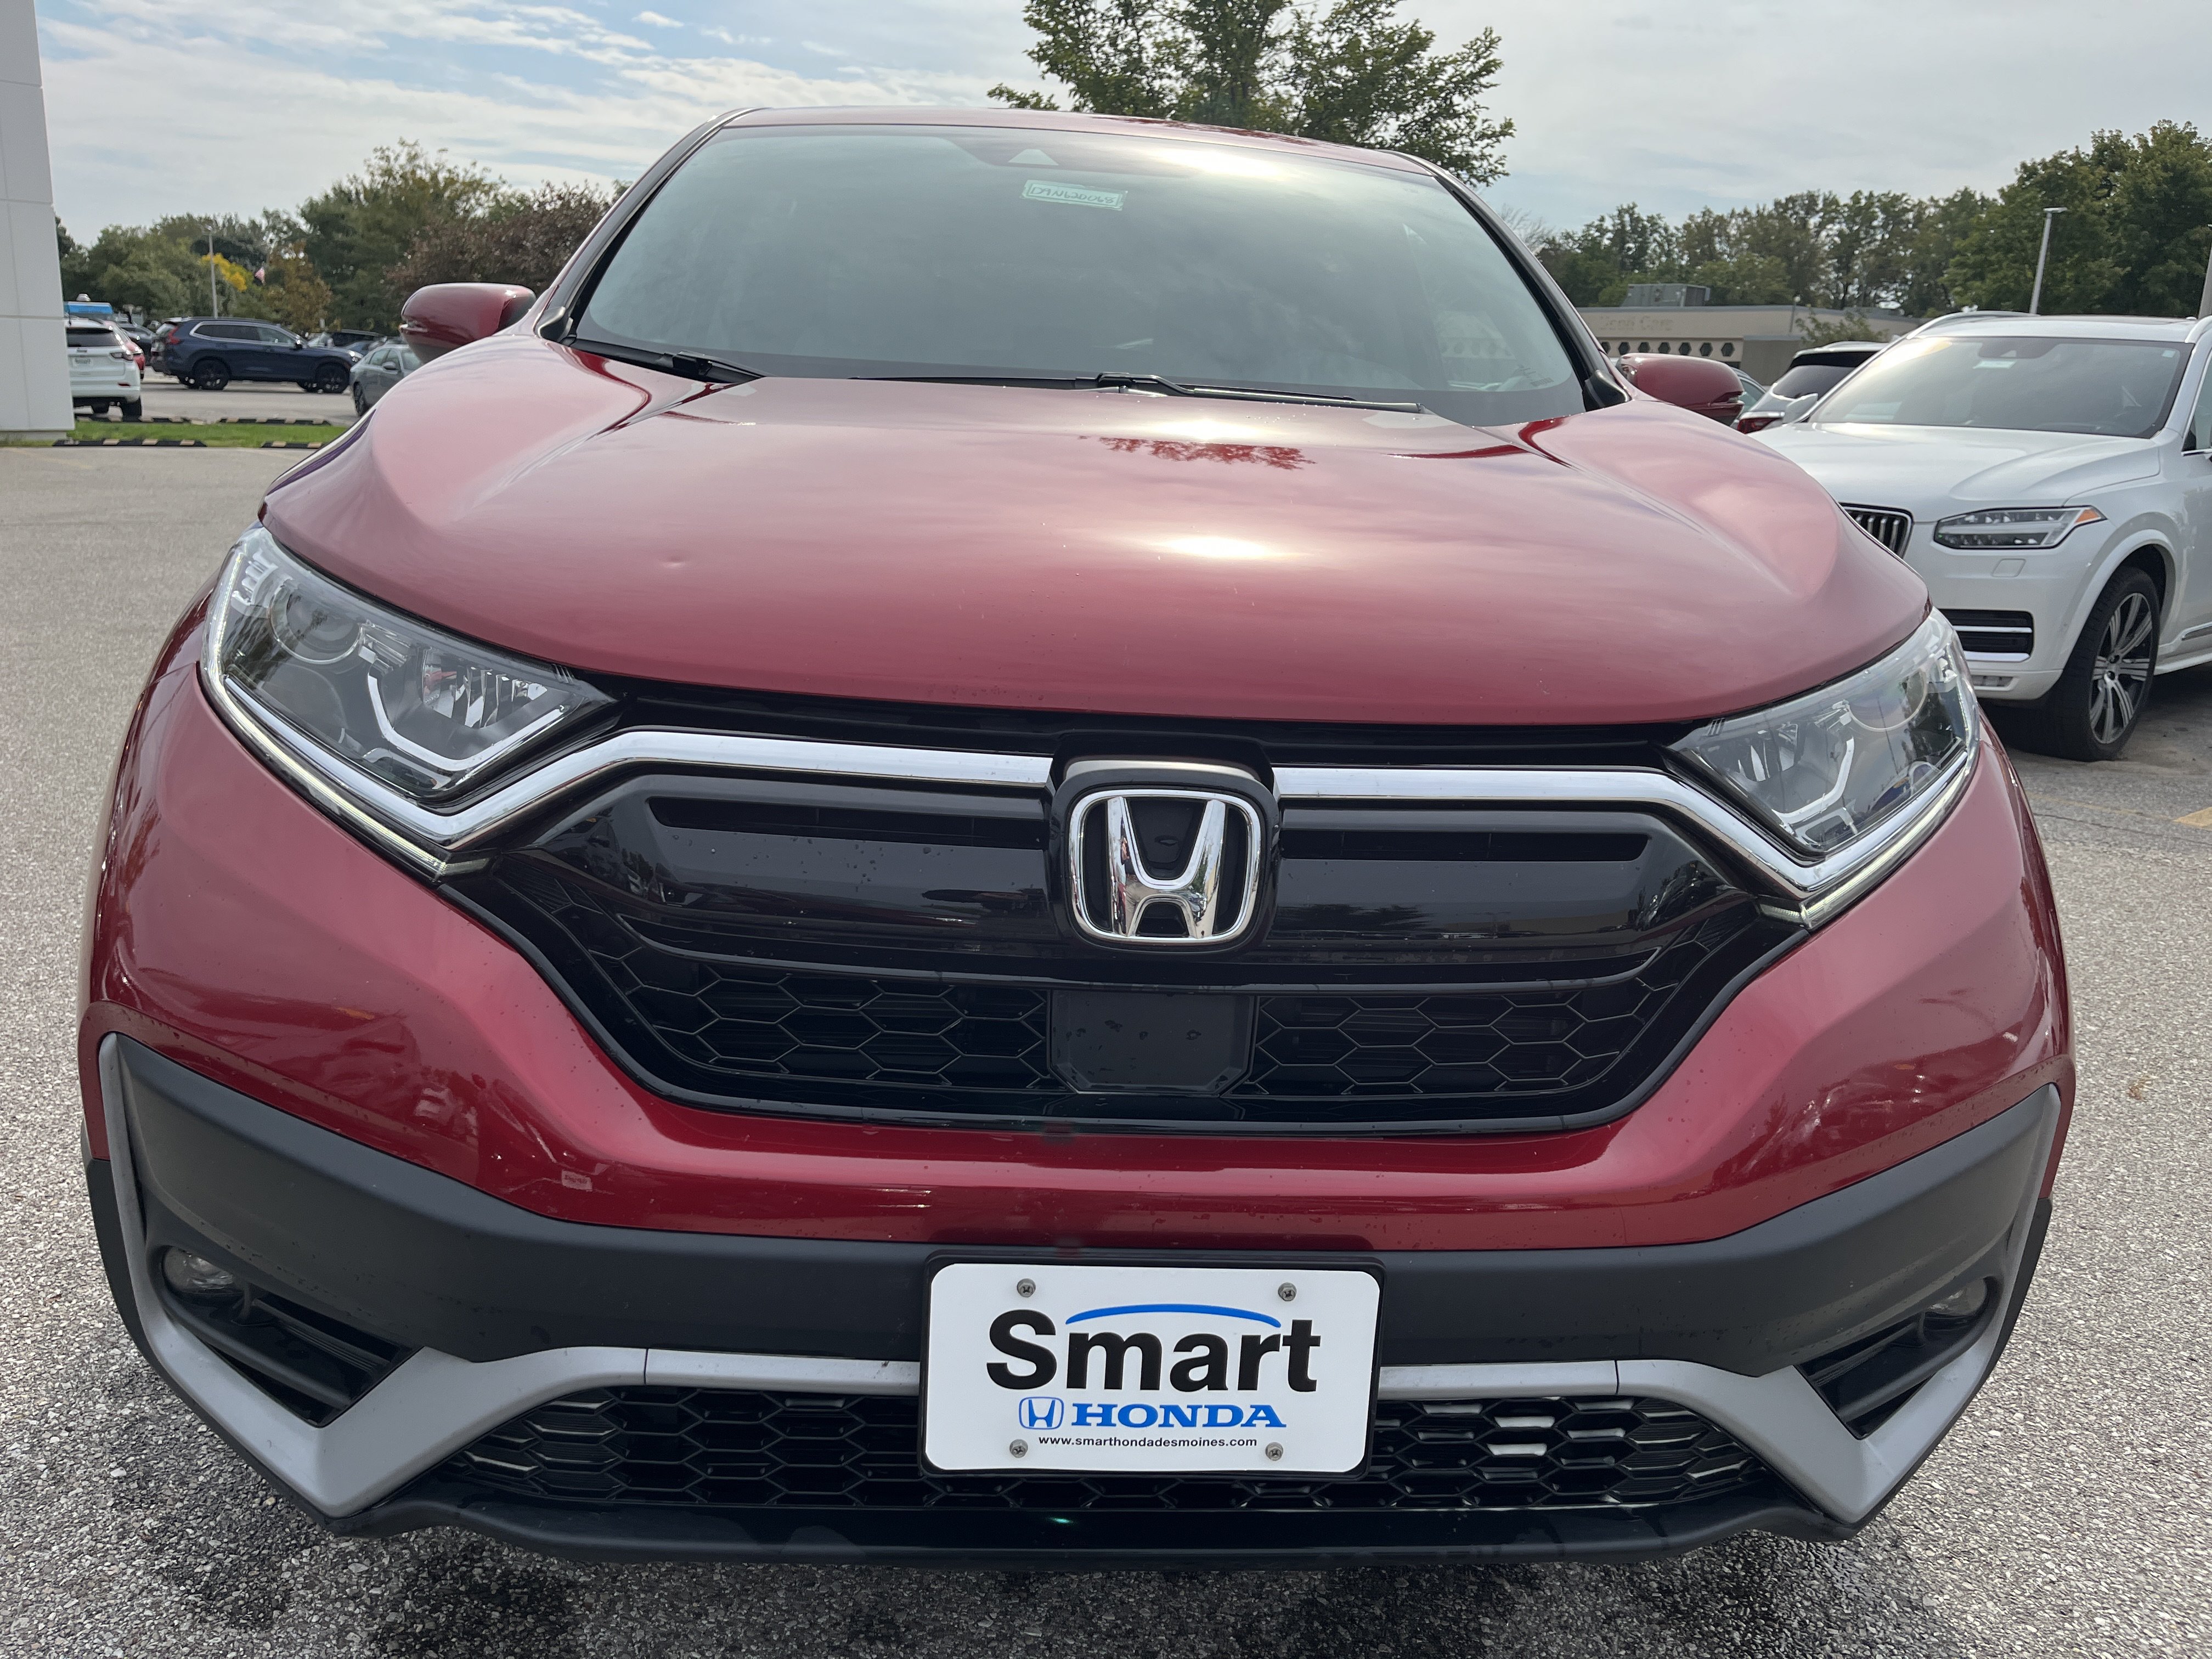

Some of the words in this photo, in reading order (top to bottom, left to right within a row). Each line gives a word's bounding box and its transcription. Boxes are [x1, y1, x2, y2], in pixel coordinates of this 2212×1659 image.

[986, 1309, 1321, 1392] Smart
[1071, 1403, 1287, 1429] HONDA
[1038, 1436, 1257, 1448] www.smarthondadesmoines.com
